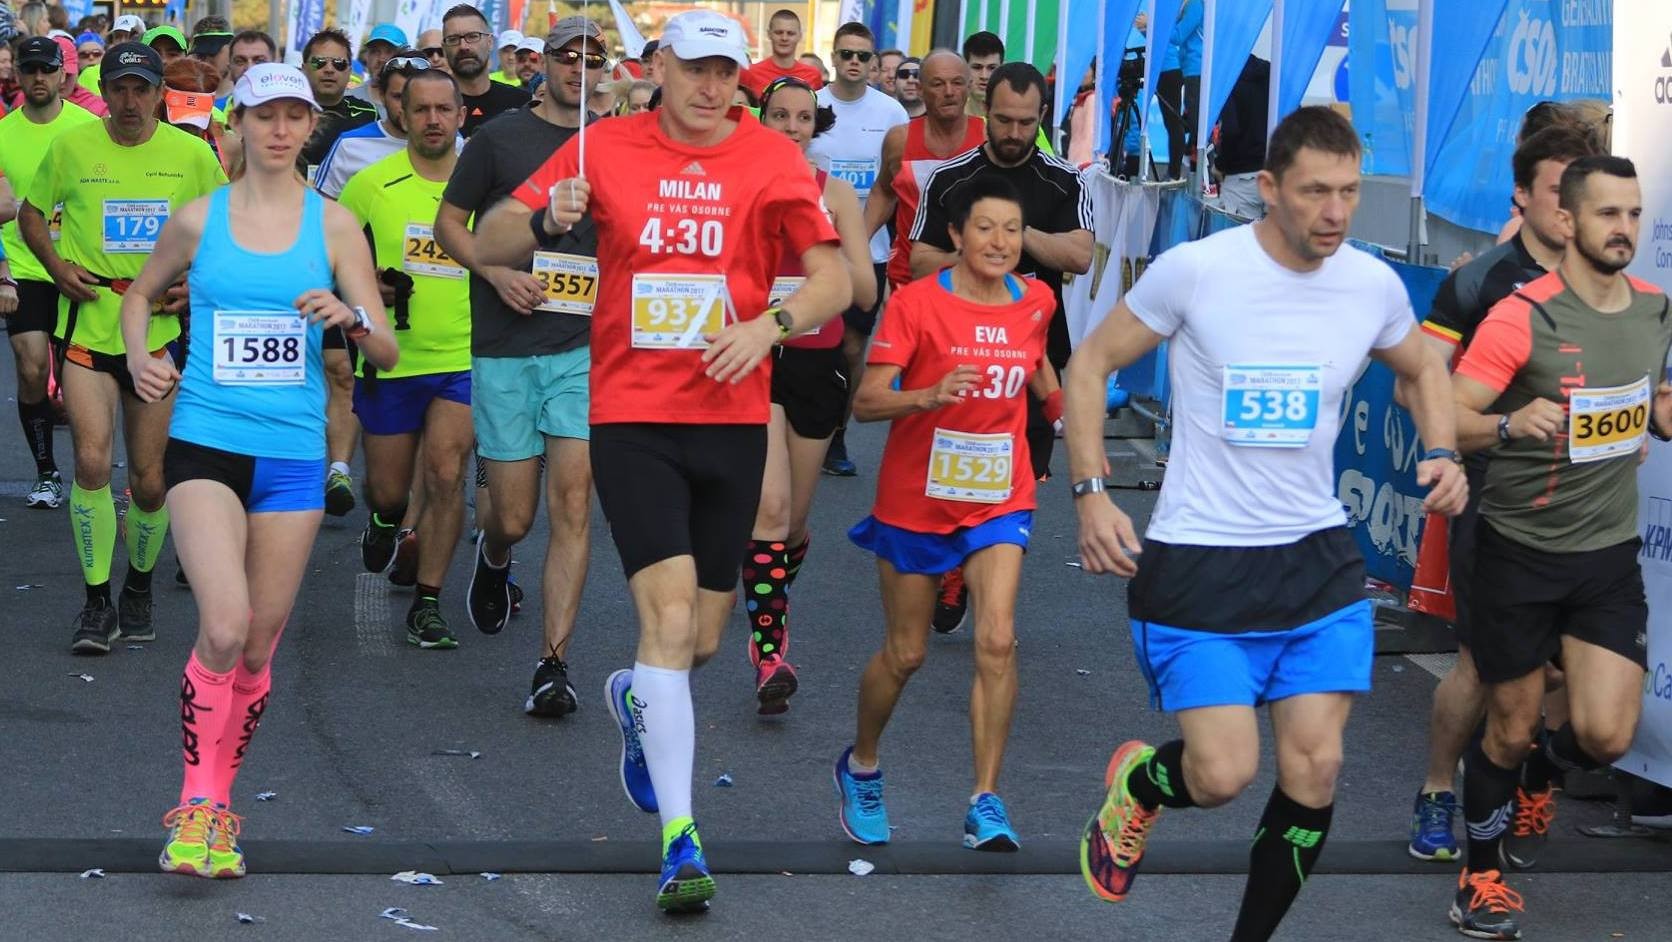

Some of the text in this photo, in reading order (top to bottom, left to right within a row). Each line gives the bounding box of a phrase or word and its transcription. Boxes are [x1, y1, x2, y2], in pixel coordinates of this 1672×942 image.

[659, 179, 721, 201] MILAN
[647, 203, 665, 213] PRE
[116, 216, 160, 236] 179
[639, 217, 724, 257] 4:30
[537, 271, 595, 297] 3557
[975, 326, 1008, 344] EVA
[223, 336, 300, 363] 1588
[951, 346, 969, 356] PRE
[958, 364, 1025, 399] :30
[1240, 390, 1307, 421] 538
[1576, 404, 1646, 440] 3600
[938, 454, 1009, 483] 1529
